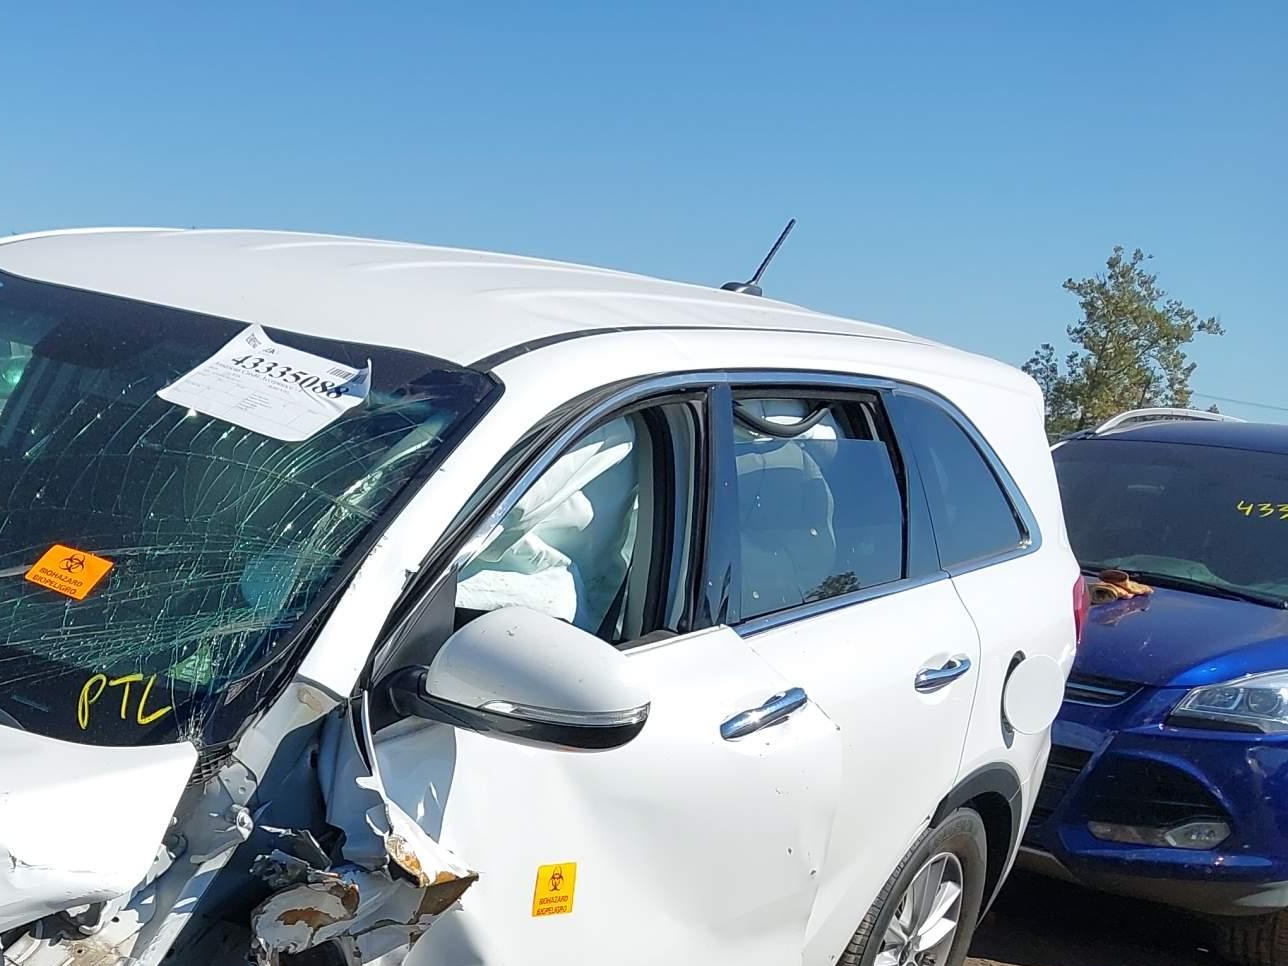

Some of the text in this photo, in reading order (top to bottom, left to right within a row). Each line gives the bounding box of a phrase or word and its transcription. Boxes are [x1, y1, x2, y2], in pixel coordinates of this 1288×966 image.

[231, 354, 349, 399] 43335088
[32, 575, 78, 595] BIOPELIGRO
[39, 567, 83, 587] BIOHAZARD
